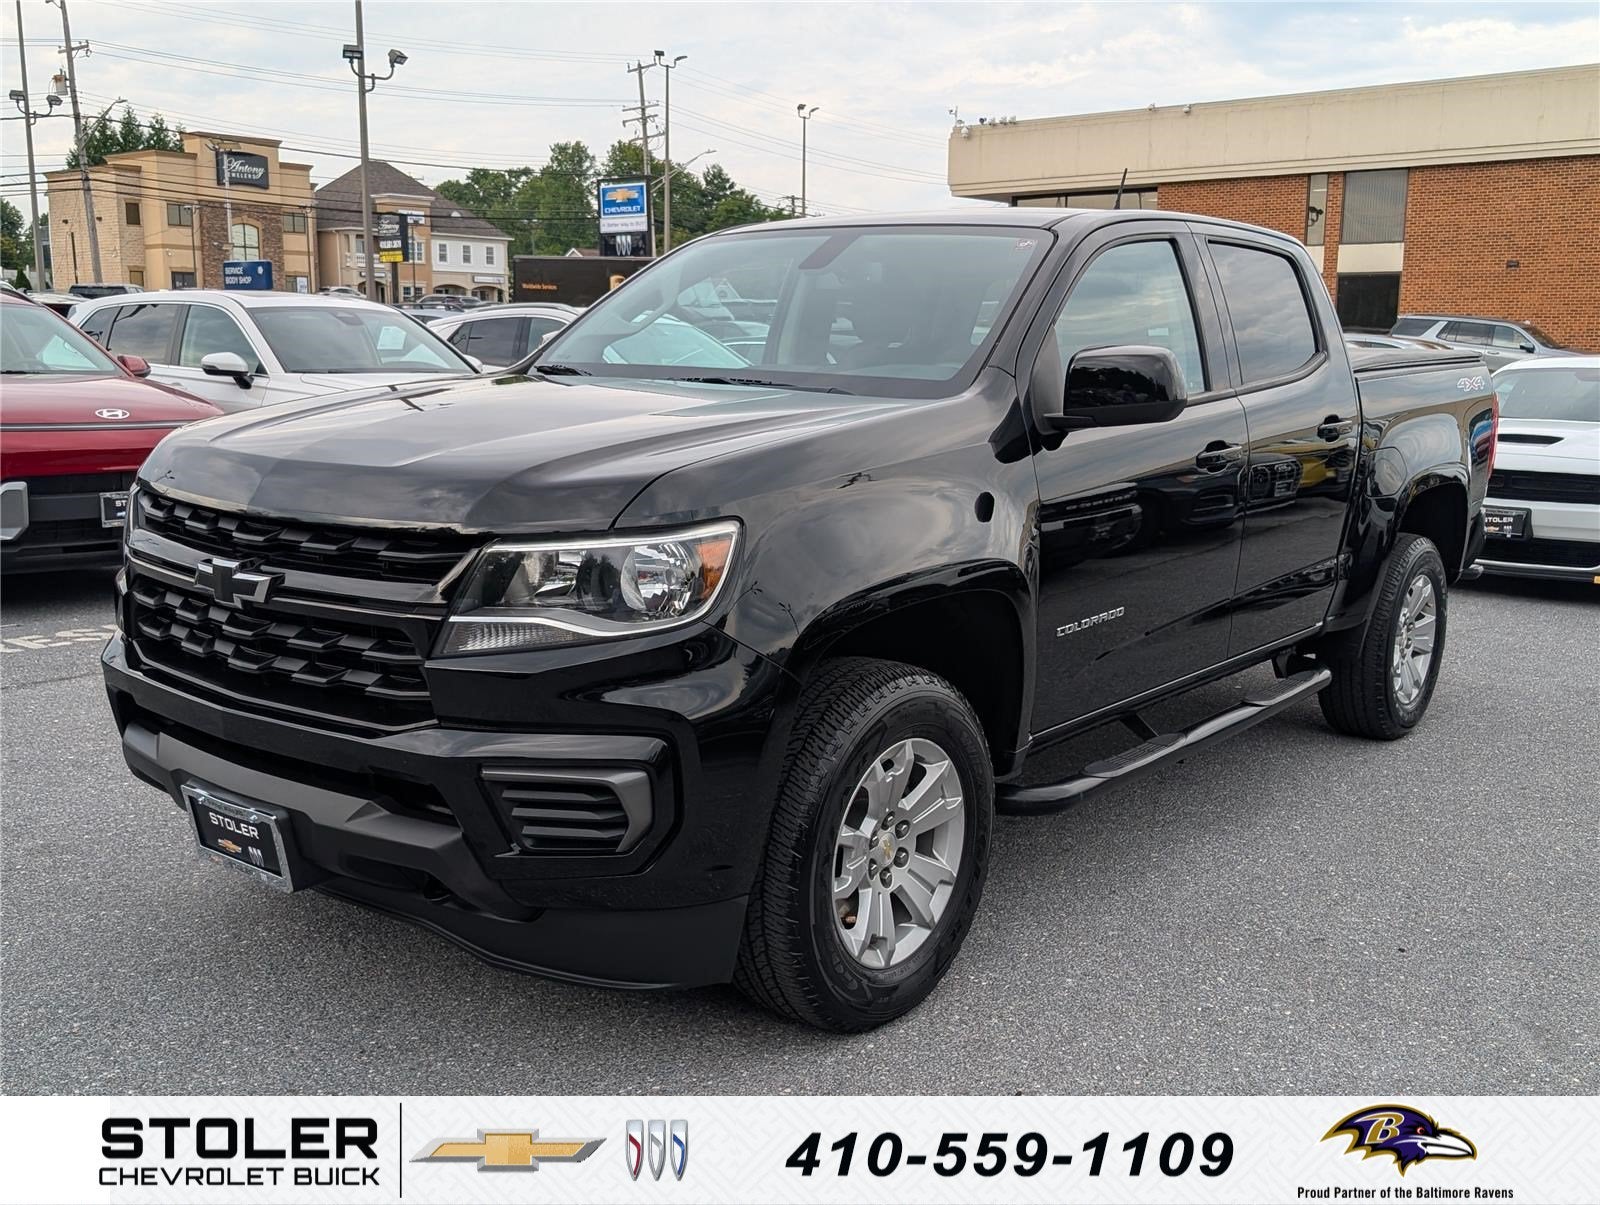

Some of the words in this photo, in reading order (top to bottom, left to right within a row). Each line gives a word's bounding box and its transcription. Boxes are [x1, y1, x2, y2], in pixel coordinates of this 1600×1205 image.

[226, 157, 265, 179] Antony
[604, 206, 641, 214] CHEVROLET
[224, 267, 244, 275] SERVICE
[225, 276, 239, 285] BODY
[239, 276, 252, 285] SHOP
[1056, 606, 1125, 637] COLORADO
[209, 812, 260, 840] STOLER
